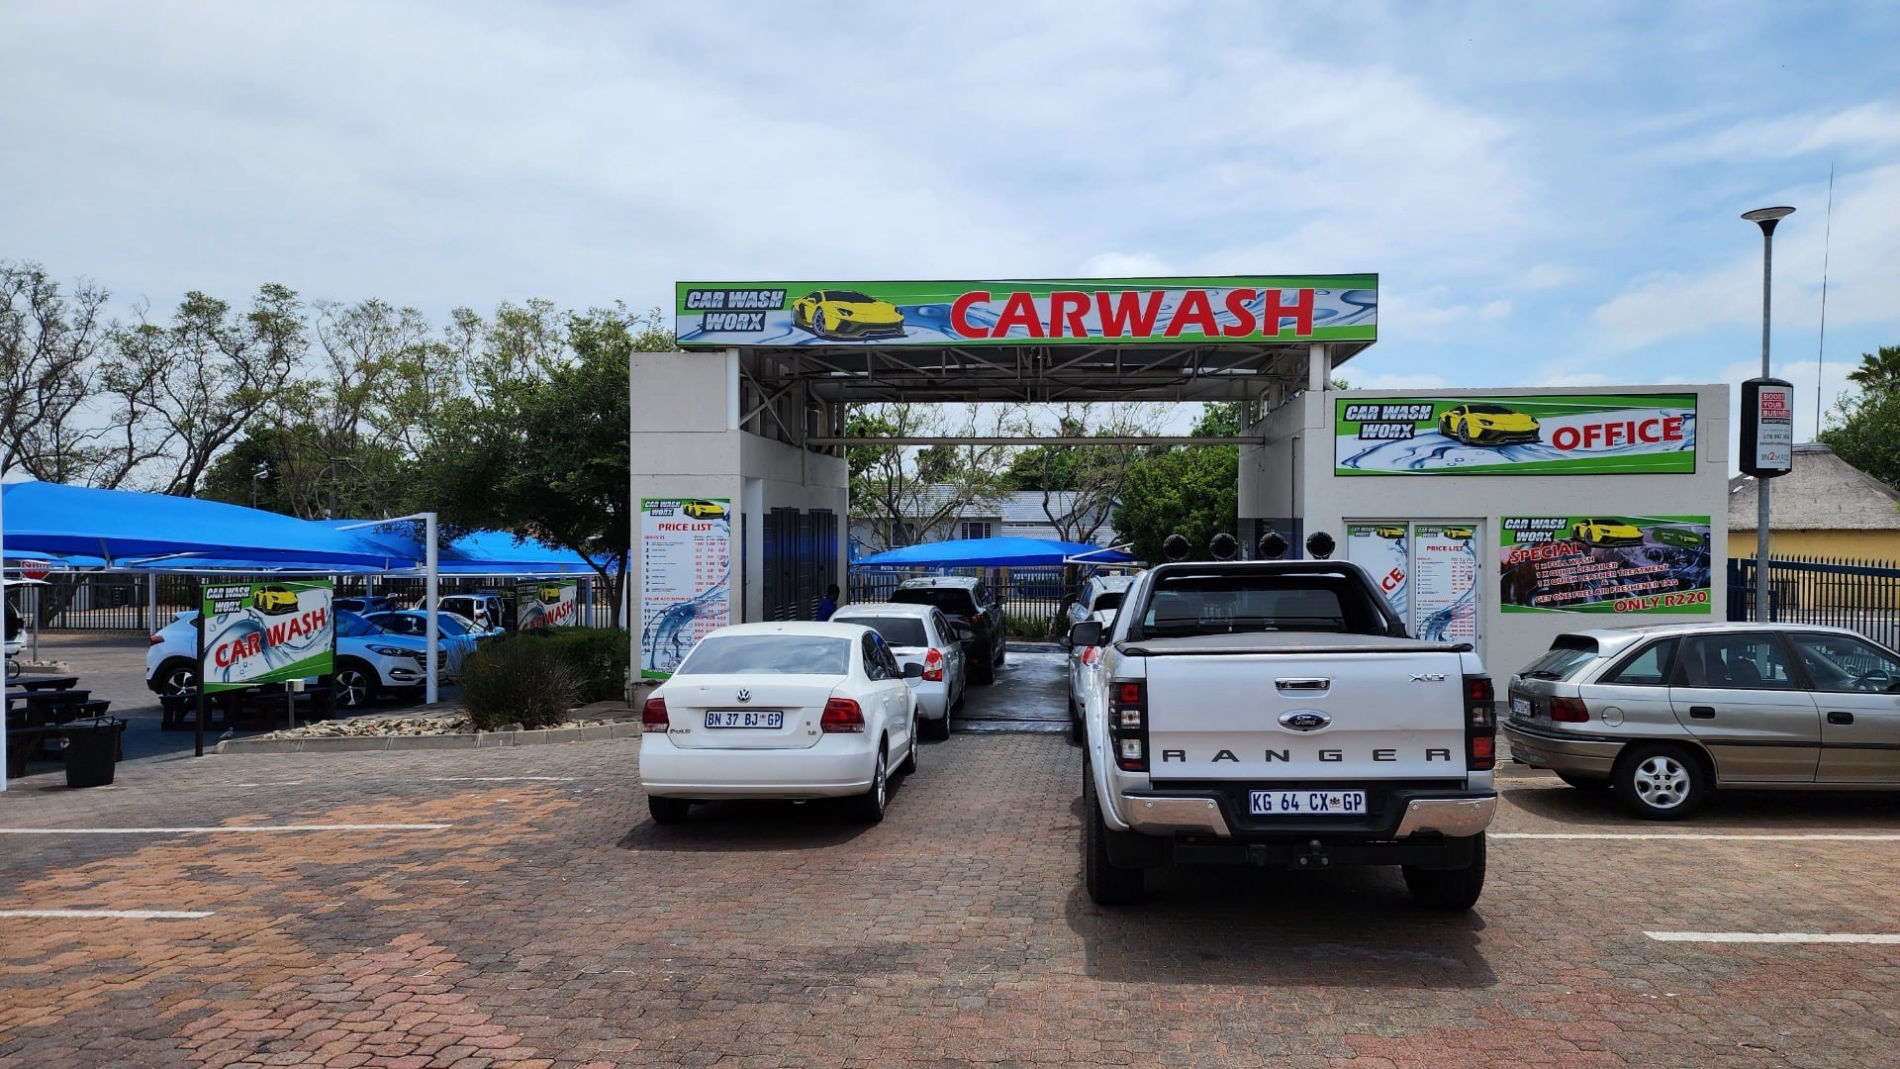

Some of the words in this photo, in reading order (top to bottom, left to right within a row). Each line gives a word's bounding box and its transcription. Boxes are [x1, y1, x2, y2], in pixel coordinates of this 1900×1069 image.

[687, 291, 725, 309] CAR
[727, 290, 785, 308] WASH
[705, 313, 764, 331] WORX
[949, 287, 1315, 340] CARWASH
[1345, 405, 1380, 421] CAR
[1381, 404, 1432, 420] WASH
[1360, 423, 1414, 439] WORX
[1551, 416, 1684, 451] OFFICE
[658, 523, 689, 531] PRICE
[691, 523, 713, 531] LIST
[1504, 519, 1529, 529] CAR
[1529, 518, 1567, 529] WASH
[1516, 531, 1553, 542] WORX
[1510, 543, 1582, 563] SPECIAL
[1547, 560, 1569, 569] FULL
[1570, 557, 1595, 565] WASH
[1549, 568, 1577, 577] QUICK
[1578, 562, 1619, 573] DETAILER
[1380, 567, 1405, 595] ICE
[1551, 575, 1578, 585] QUICK
[1579, 570, 1617, 582] LEATHER
[1618, 563, 1670, 576] TREATMENT
[207, 588, 224, 599] CAR
[225, 586, 250, 598] WASH
[1536, 594, 1552, 603] GET
[1553, 592, 1571, 601] ONE
[1572, 590, 1593, 599] FREE
[1594, 586, 1610, 595] AIR
[1610, 581, 1660, 594] FRESHENER
[1661, 579, 1679, 587] TAG
[214, 601, 241, 613] WORX
[1614, 596, 1660, 612] ONLY
[1664, 591, 1707, 606] R220
[545, 598, 573, 625] WASH
[215, 632, 261, 668] CAR
[265, 607, 326, 648] WASH
[707, 713, 721, 726] BN
[726, 713, 739, 726] 37
[745, 713, 758, 726] BJ
[767, 712, 781, 726] GP
[1162, 748, 1451, 763] RANGER
[1252, 792, 1272, 812] KG
[1281, 792, 1299, 812] 64
[1309, 792, 1329, 812] CX
[1343, 792, 1362, 812] GP
